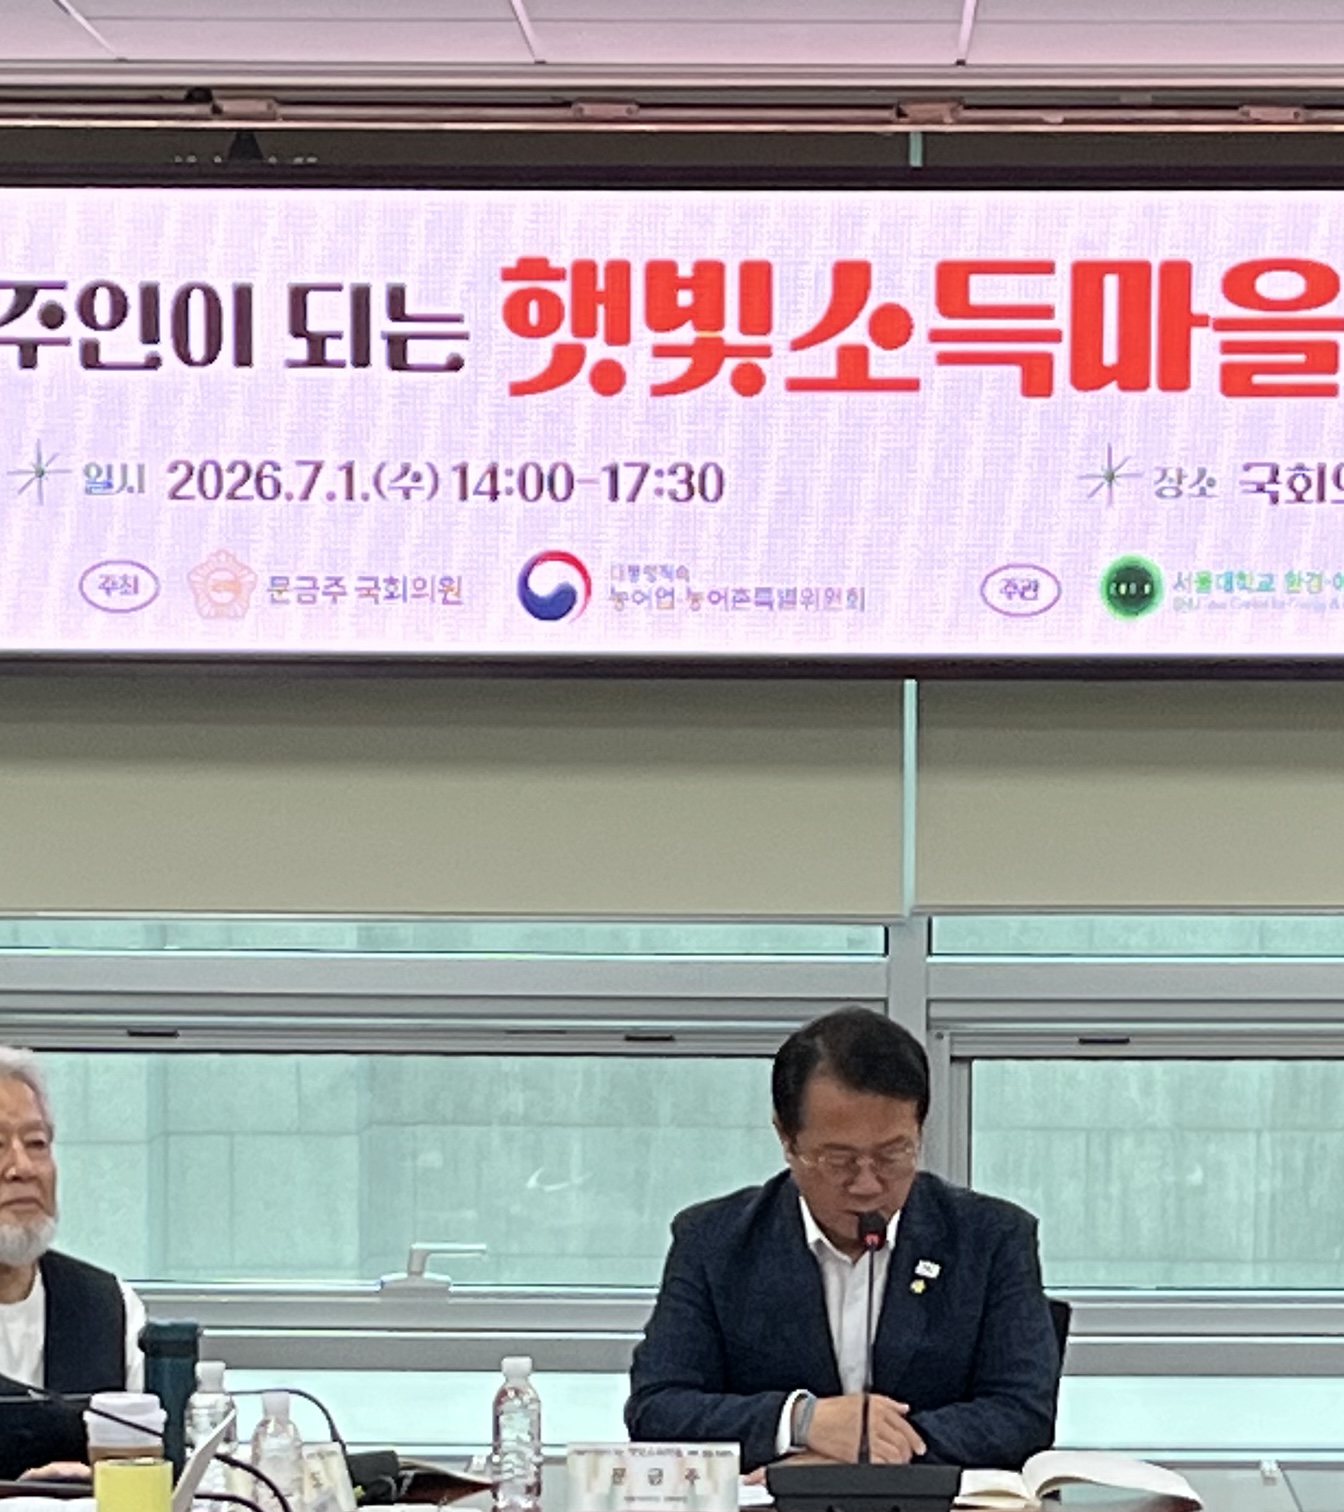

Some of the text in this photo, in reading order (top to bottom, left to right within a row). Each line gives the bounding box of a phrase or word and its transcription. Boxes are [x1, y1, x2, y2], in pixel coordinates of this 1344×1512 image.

[285, 283, 470, 373] 되는
[82, 459, 725, 503] 일시 2026.7.1.(수) 14:00-17:30
[1154, 466, 1217, 500] 장소
[97, 573, 140, 597] 주최
[266, 575, 463, 606] 문금주 국회의원
[1173, 570, 1275, 594] 서울대학교
